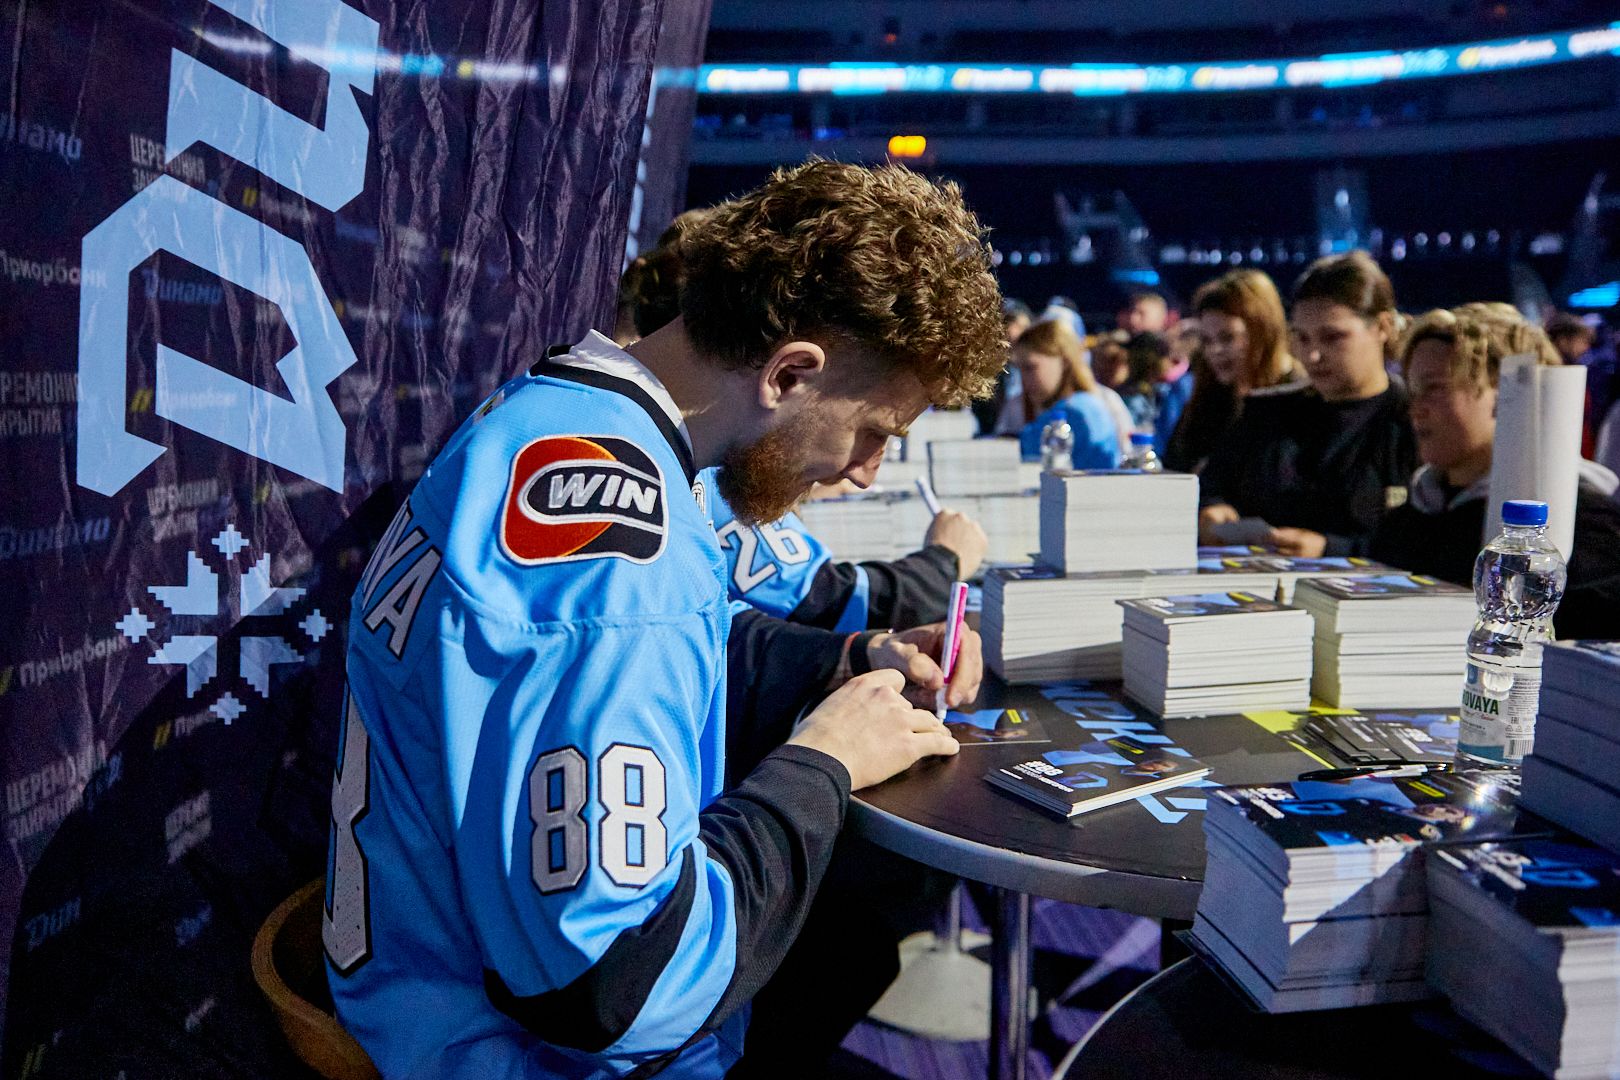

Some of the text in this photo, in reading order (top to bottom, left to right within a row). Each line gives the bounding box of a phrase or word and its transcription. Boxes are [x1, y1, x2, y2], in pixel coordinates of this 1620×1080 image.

[549, 473, 657, 515] WIN
[715, 515, 812, 594] 26
[529, 741, 667, 896] 88
